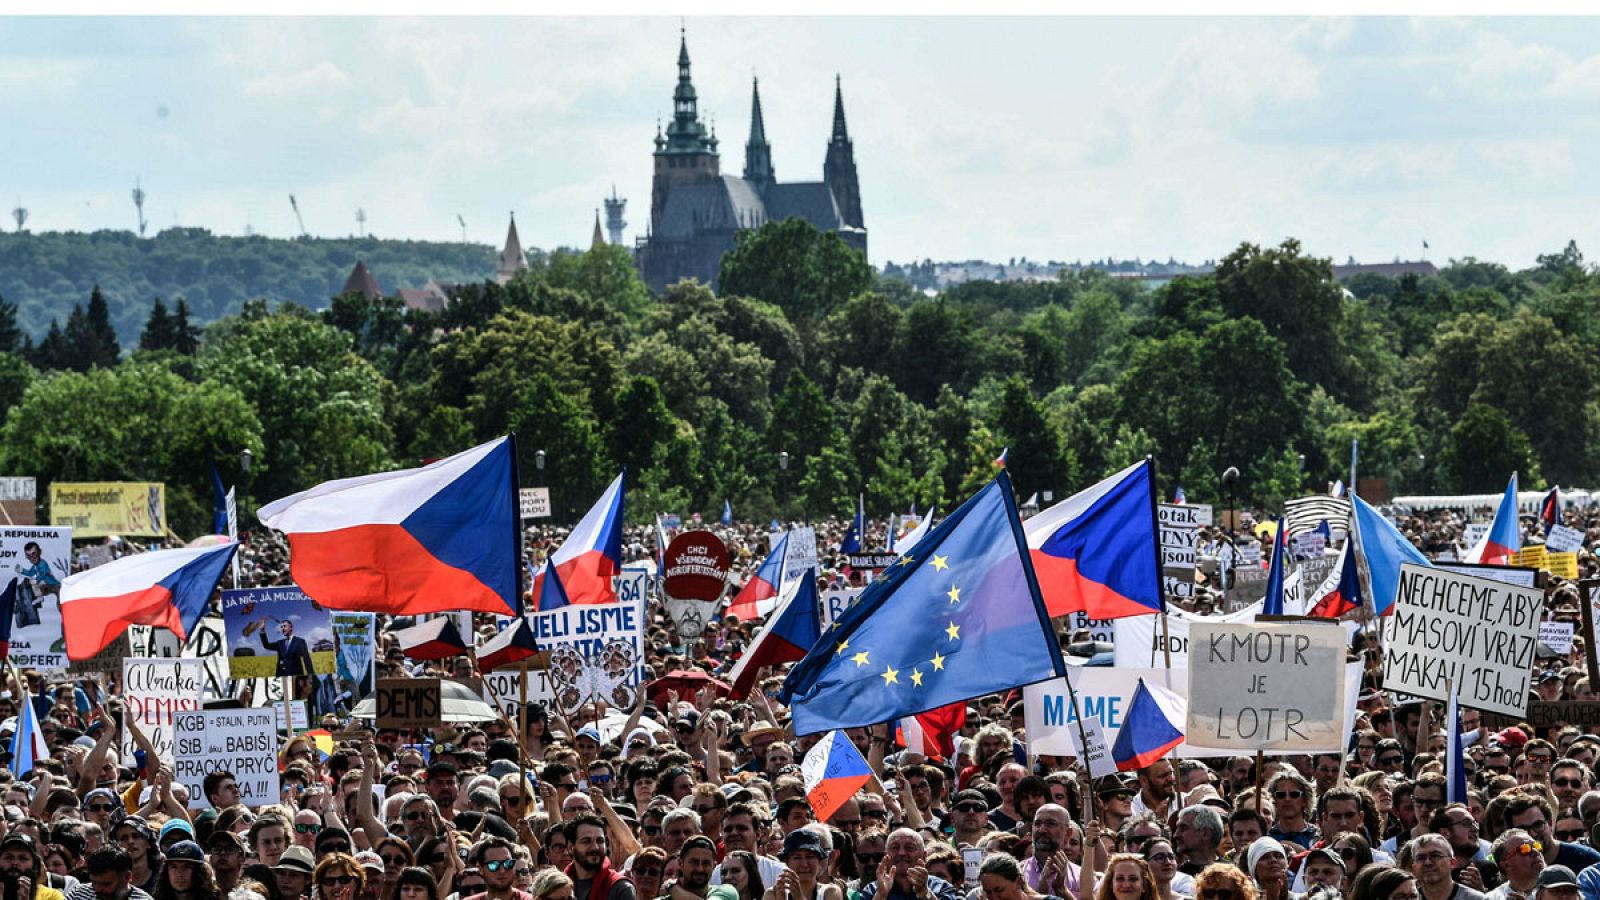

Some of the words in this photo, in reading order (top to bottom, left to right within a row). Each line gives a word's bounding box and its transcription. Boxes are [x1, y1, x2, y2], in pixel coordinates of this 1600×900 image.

[1171, 508, 1197, 523] tak
[4, 530, 59, 538] REPUBLIKA
[687, 545, 708, 555] CHCI
[1162, 548, 1195, 565] jsou
[225, 598, 238, 608] JÁ
[259, 591, 272, 602] JÁ
[1397, 570, 1498, 626] NECHCEME,
[1498, 592, 1542, 630] ABY
[576, 606, 636, 634] JSME
[1208, 631, 1310, 666] KMOTR
[1392, 609, 1482, 658] MASOVÍ
[1484, 627, 1536, 671] VRAZI
[1247, 674, 1267, 694] JE
[1471, 667, 1494, 702] 15
[1493, 671, 1527, 710] hod.
[376, 687, 441, 719] DEMISI
[1043, 689, 1121, 728] MÁME
[176, 715, 205, 732] KGB
[215, 716, 245, 728] STALIN,
[247, 715, 270, 727] PUTIN
[1216, 707, 1310, 741] LOTR
[179, 738, 202, 754] StB
[226, 732, 274, 753] BABIŠI,
[176, 759, 232, 777] PRACKY
[235, 753, 274, 775] PRYČ
[256, 781, 269, 798] !!!
